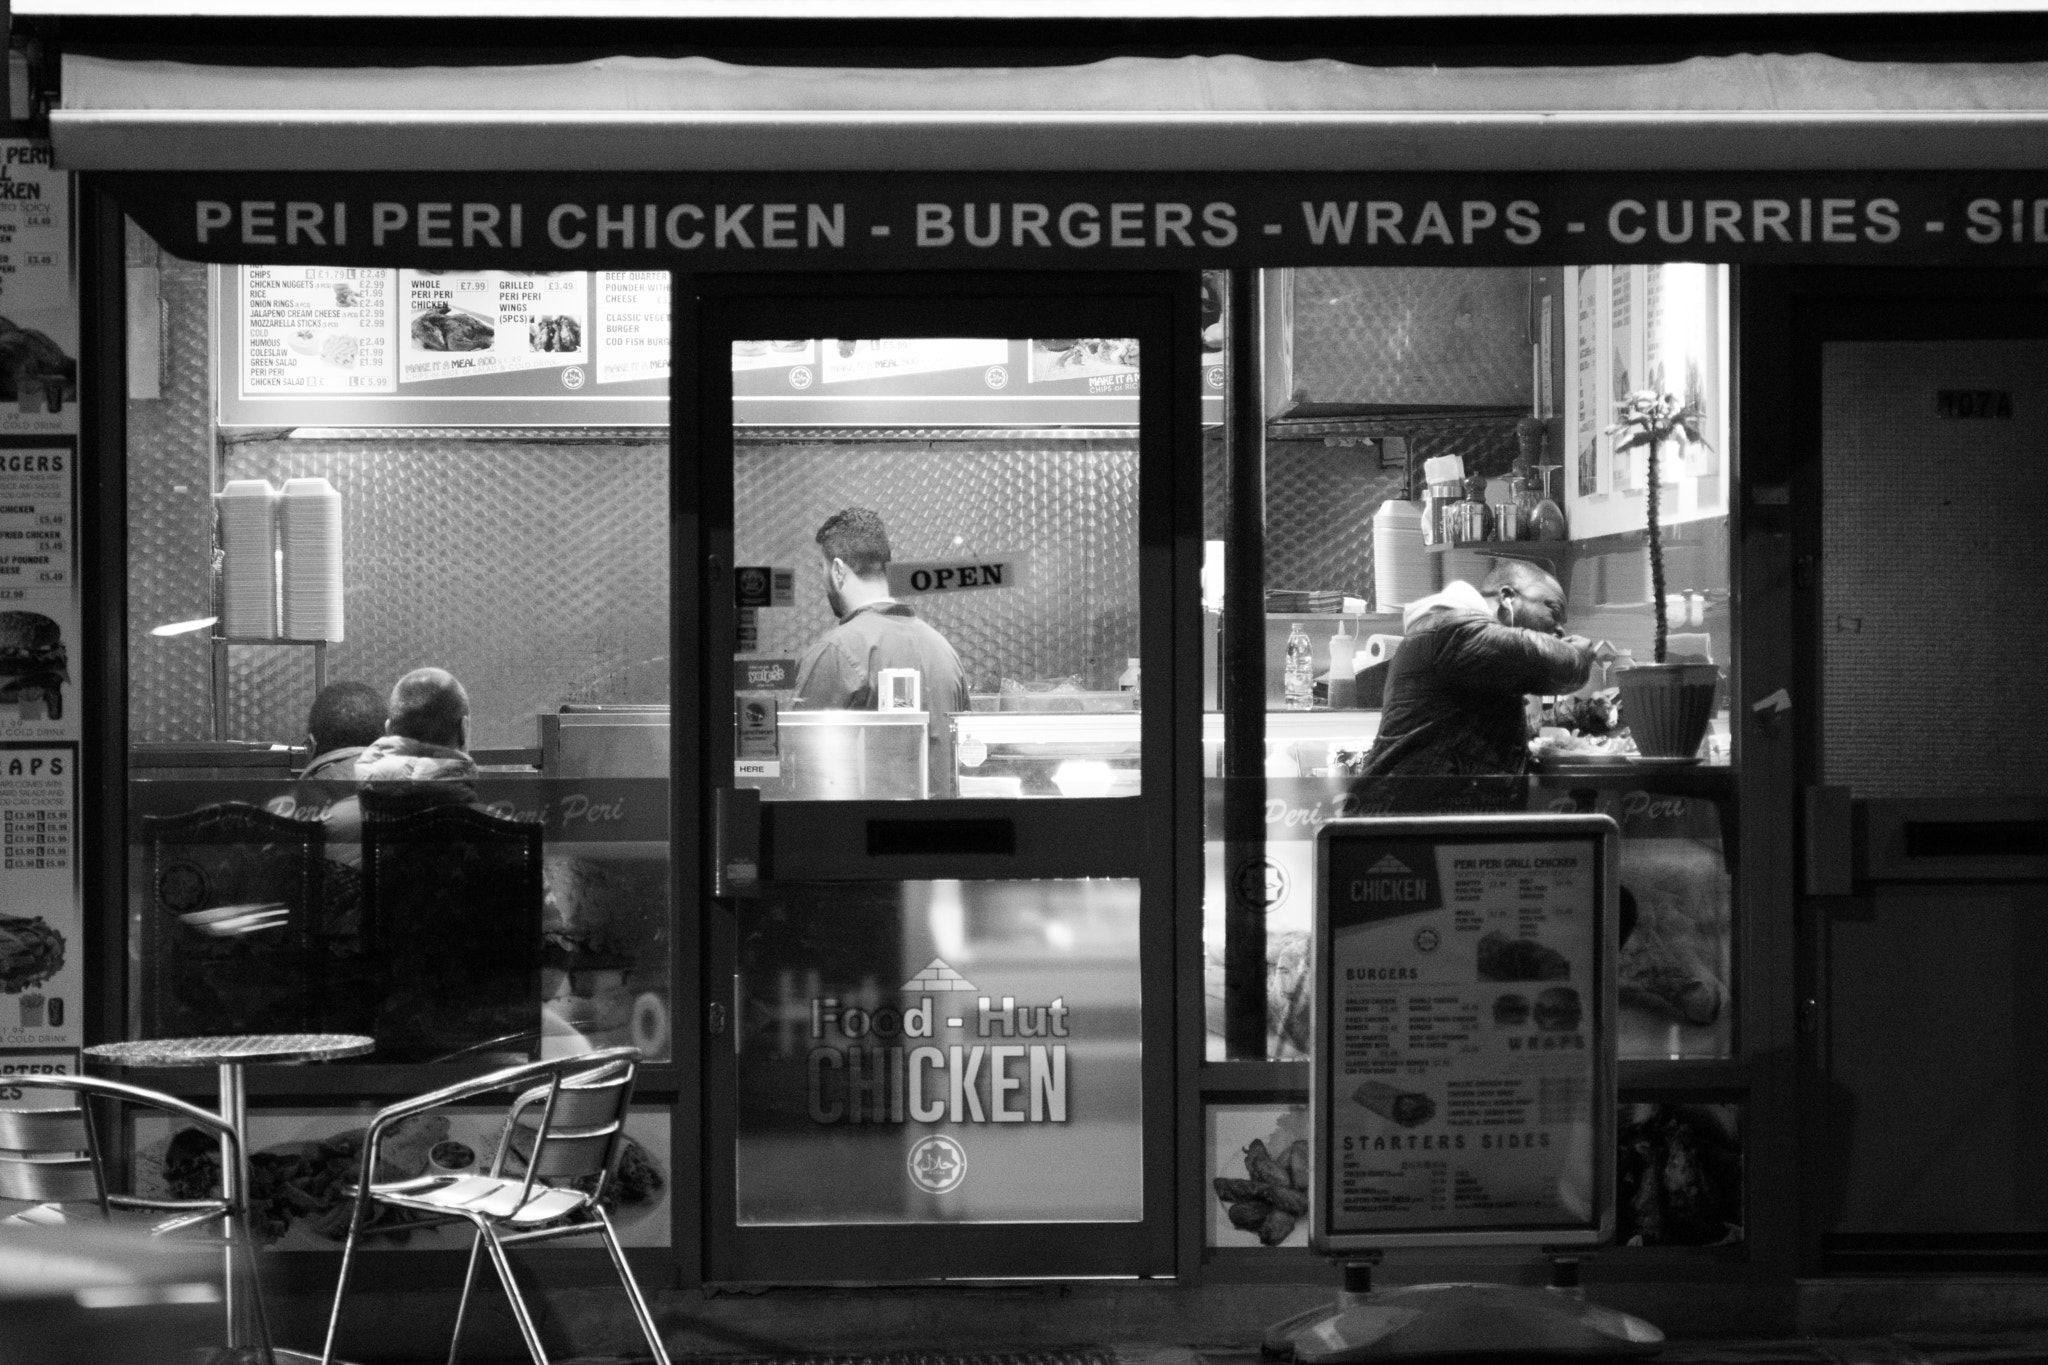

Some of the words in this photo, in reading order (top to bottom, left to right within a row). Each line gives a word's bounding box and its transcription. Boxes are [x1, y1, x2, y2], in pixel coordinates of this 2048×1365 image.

[196, 200, 346, 246] PERI
[373, 202, 523, 248] PERI
[547, 203, 845, 249] CHICKEN
[916, 203, 1239, 247] BURGERS
[1301, 200, 1542, 245] WRAPS
[1608, 198, 1902, 244] CURRIES
[250, 270, 271, 279] CHIPS
[318, 271, 345, 279] £1.79
[360, 270, 386, 279] £2.49
[605, 272, 626, 281] BEEF
[629, 272, 667, 281] QUARTER
[250, 280, 280, 289] CHICKEN
[282, 280, 314, 289] NUGGETS
[359, 280, 385, 289] £2.99
[411, 280, 440, 289] WHOLE
[460, 281, 486, 291] £7.99
[499, 281, 534, 290] GRILLED
[548, 281, 574, 290] £3.49
[605, 283, 645, 292] POUNDER
[250, 289, 267, 298] RICE
[359, 289, 384, 298] £1.99
[411, 290, 431, 299] PERI
[433, 290, 453, 299] PERI
[499, 292, 519, 301] PERI
[522, 292, 542, 301] PERI
[250, 299, 272, 308] ONION
[273, 299, 294, 308] RINGS
[359, 299, 385, 308] £2.49
[605, 294, 638, 304] CHEESE
[411, 300, 449, 310] CHICKEN
[499, 303, 528, 312] WINGS
[250, 309, 285, 318] JALAPENO
[287, 309, 313, 318] CREAM
[314, 309, 341, 318] CHEESE
[359, 309, 385, 318] £2.99
[606, 313, 642, 322] CLASSIC
[250, 319, 295, 328] MOZZARELLA
[296, 319, 321, 328] STICKS
[359, 319, 385, 328] £2.99
[499, 314, 528, 325] (5PCS)
[606, 324, 640, 333] BURGER
[250, 329, 268, 338] COLD
[250, 338, 280, 347] HUMOUS
[359, 337, 385, 347] £2.49
[605, 337, 623, 346] COD
[625, 337, 645, 346] FISH
[883, 341, 908, 350] £5.99
[250, 348, 288, 357] COLESLAW
[359, 348, 384, 357] £1.99
[250, 358, 274, 367] GREEN
[275, 358, 298, 367] SALAD
[359, 358, 384, 367] £1.99
[451, 357, 477, 369] MEAL
[875, 359, 900, 369] MEAL
[250, 367, 267, 376] PERI
[268, 367, 285, 376] PERI
[250, 377, 281, 386] CHICKEN
[283, 377, 305, 386] SALAD
[1089, 375, 1115, 387] MAKE
[1115, 374, 1125, 385] IT
[1126, 373, 1134, 383] A
[0, 505, 35, 514] CHICKEN
[25, 531, 61, 539] CHICKEN
[909, 563, 1005, 592] OPEN
[748, 669, 774, 684] yelp
[0, 757, 64, 776] APS
[739, 765, 765, 773] HERE
[560, 793, 625, 828] Peri
[1454, 858, 1477, 869] PERI
[1479, 858, 1501, 869] PERI
[1350, 878, 1428, 903] CHICKEN
[1346, 967, 1419, 981] BURGERS
[811, 996, 934, 1039] Food
[977, 995, 1070, 1039] Hut
[7, 1035, 35, 1044] COLD
[38, 1035, 67, 1043] DRINK
[1508, 1035, 1586, 1051] WRAPS
[807, 1044, 1068, 1125] CHICKEN
[1343, 1134, 1467, 1151] STARTERS
[1480, 1132, 1551, 1149] SIDES
